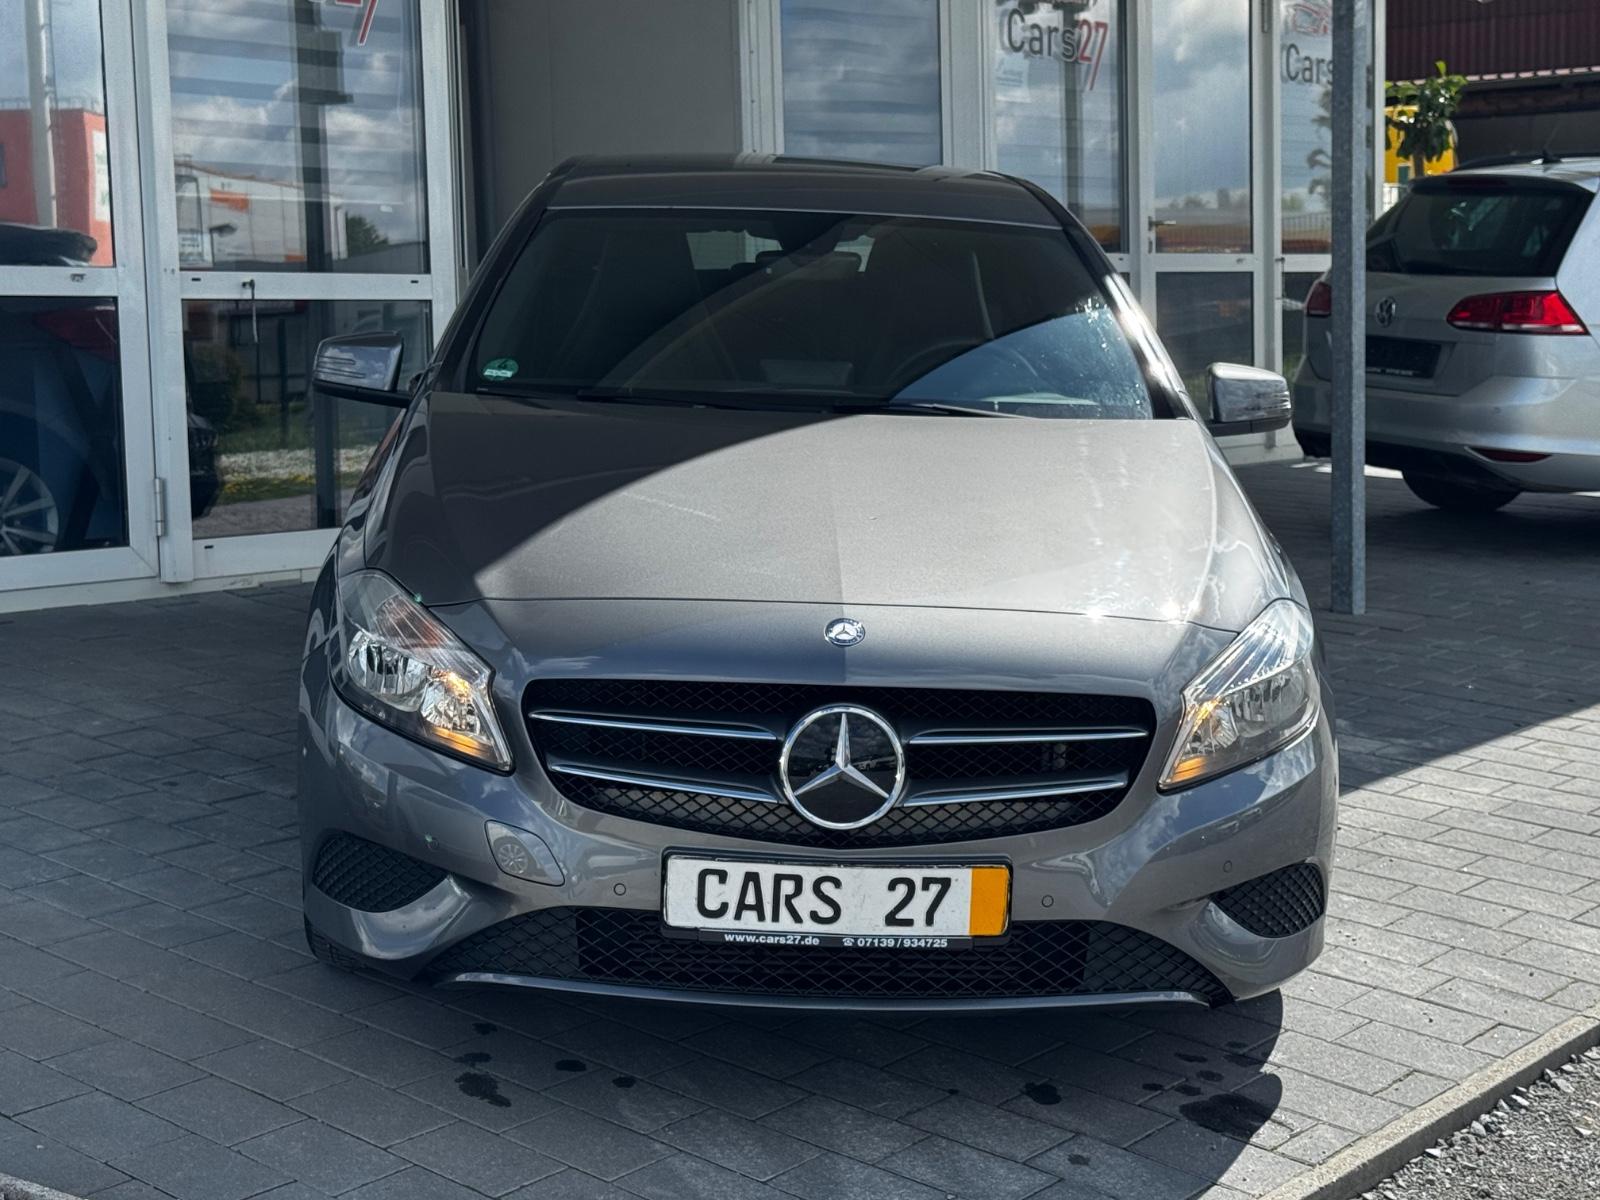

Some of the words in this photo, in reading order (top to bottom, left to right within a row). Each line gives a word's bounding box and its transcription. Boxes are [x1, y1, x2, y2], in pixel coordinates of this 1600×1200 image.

[1007, 8, 1108, 91] Cars27
[697, 868, 843, 925] CARS
[884, 877, 951, 927] 27
[724, 933, 820, 945] www.cars27.de
